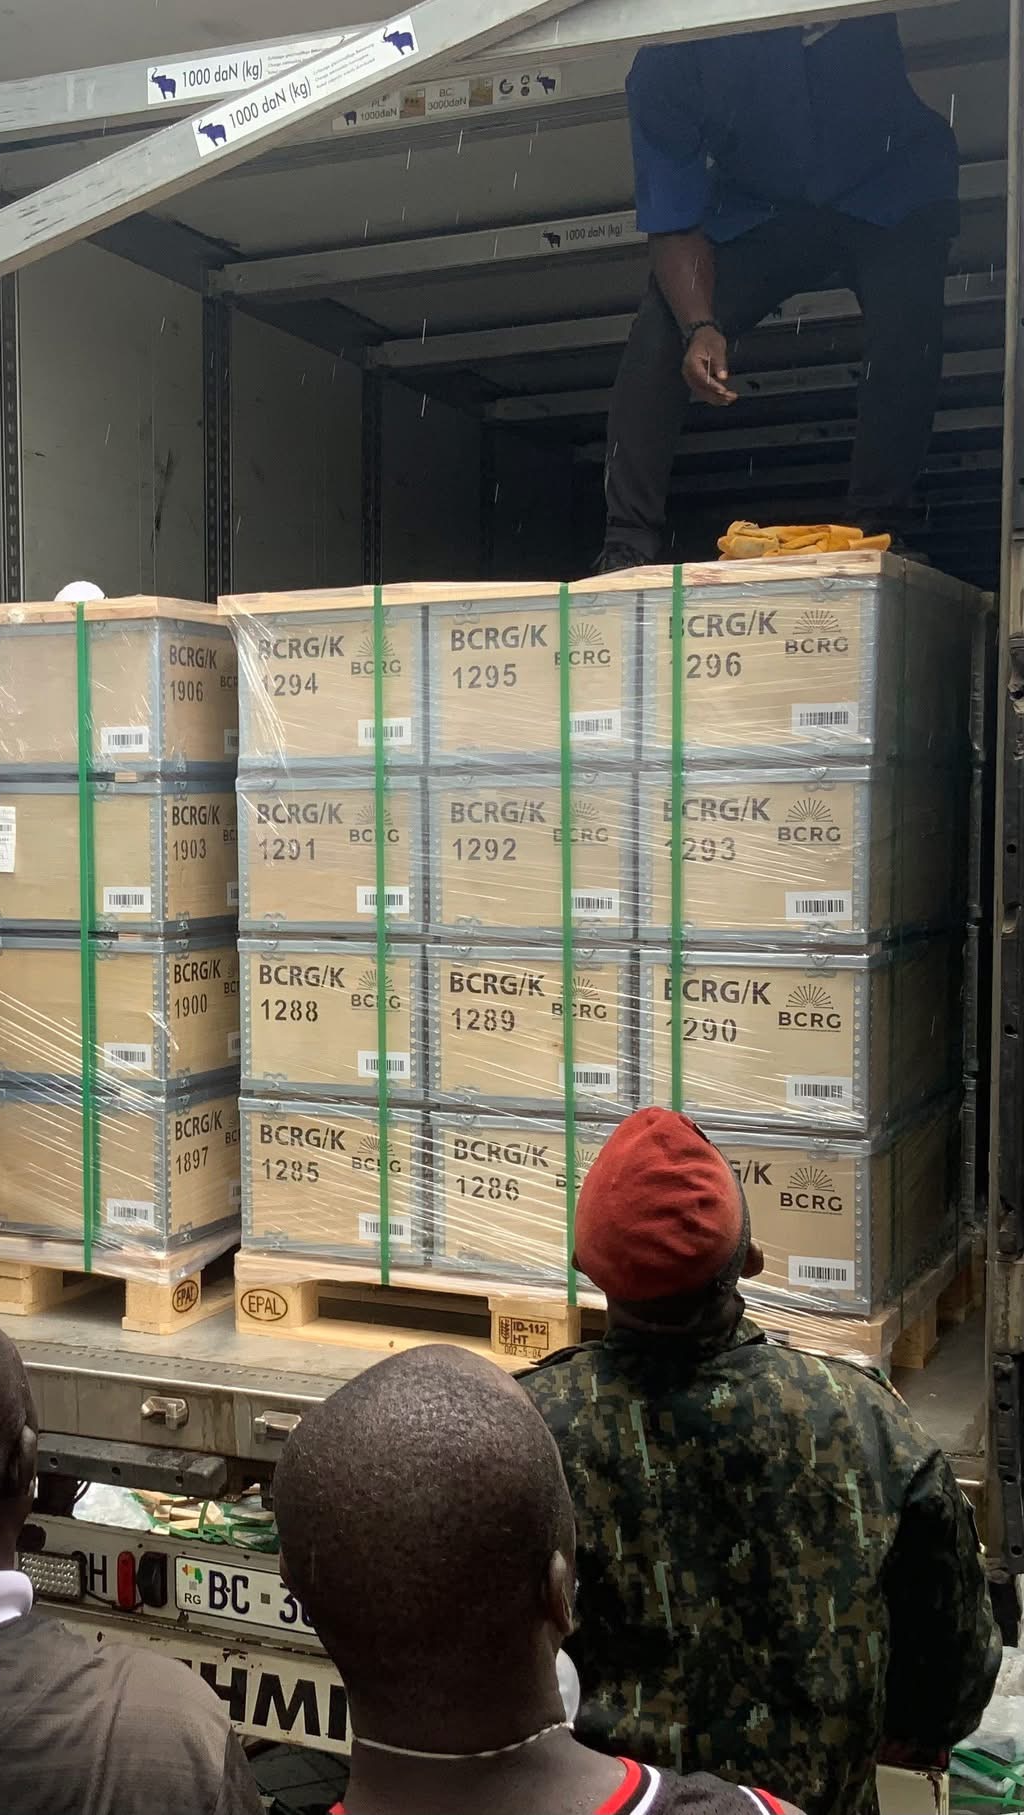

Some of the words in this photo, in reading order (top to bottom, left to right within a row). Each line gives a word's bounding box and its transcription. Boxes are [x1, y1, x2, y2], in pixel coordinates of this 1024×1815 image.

[182, 67, 210, 88] 1000
[214, 65, 238, 83] daN
[242, 59, 263, 82] (kg)
[229, 103, 259, 129] 1000
[263, 89, 288, 114] daN
[289, 76, 312, 104] (kg)
[566, 229, 586, 241] 1000
[588, 226, 606, 239] daN
[258, 635, 345, 660] BCRG/K
[450, 624, 548, 651] BCRG/K
[785, 636, 849, 655] BCRG
[169, 644, 217, 670] BCRG/K
[669, 652, 742, 679] 296
[262, 672, 318, 696] 1294
[452, 664, 518, 689] 1295
[170, 680, 204, 702] 1906
[171, 804, 220, 826] BCRG/K
[257, 802, 343, 824] BCRG/K
[450, 800, 547, 825] BCRG/K
[777, 826, 841, 843] BCRG
[172, 838, 207, 861] 1903
[452, 838, 518, 861] 1292
[174, 959, 221, 984] BCRG/K
[259, 964, 345, 989] BCRG/K
[450, 972, 545, 998] BCRG/K
[174, 995, 208, 1019] 1900
[260, 999, 319, 1022] 1288
[451, 1008, 516, 1032] 1289
[778, 1011, 841, 1029] BCRG
[175, 1110, 223, 1141] BCRG/K
[260, 1124, 346, 1151] BCRG/K
[176, 1146, 209, 1175] 1897
[454, 1139, 549, 1168] BCRG/K
[261, 1158, 319, 1183] 1285
[456, 1175, 520, 1201] 1286
[780, 1192, 843, 1212] BCRG
[176, 1286, 196, 1306] EPAL
[248, 1295, 281, 1316] EPAL
[513, 1321, 546, 1335] ID-112
[513, 1334, 528, 1344] HT
[184, 1593, 201, 1604] RG
[209, 1570, 250, 1614] BC
[279, 1582, 313, 1627] 3
